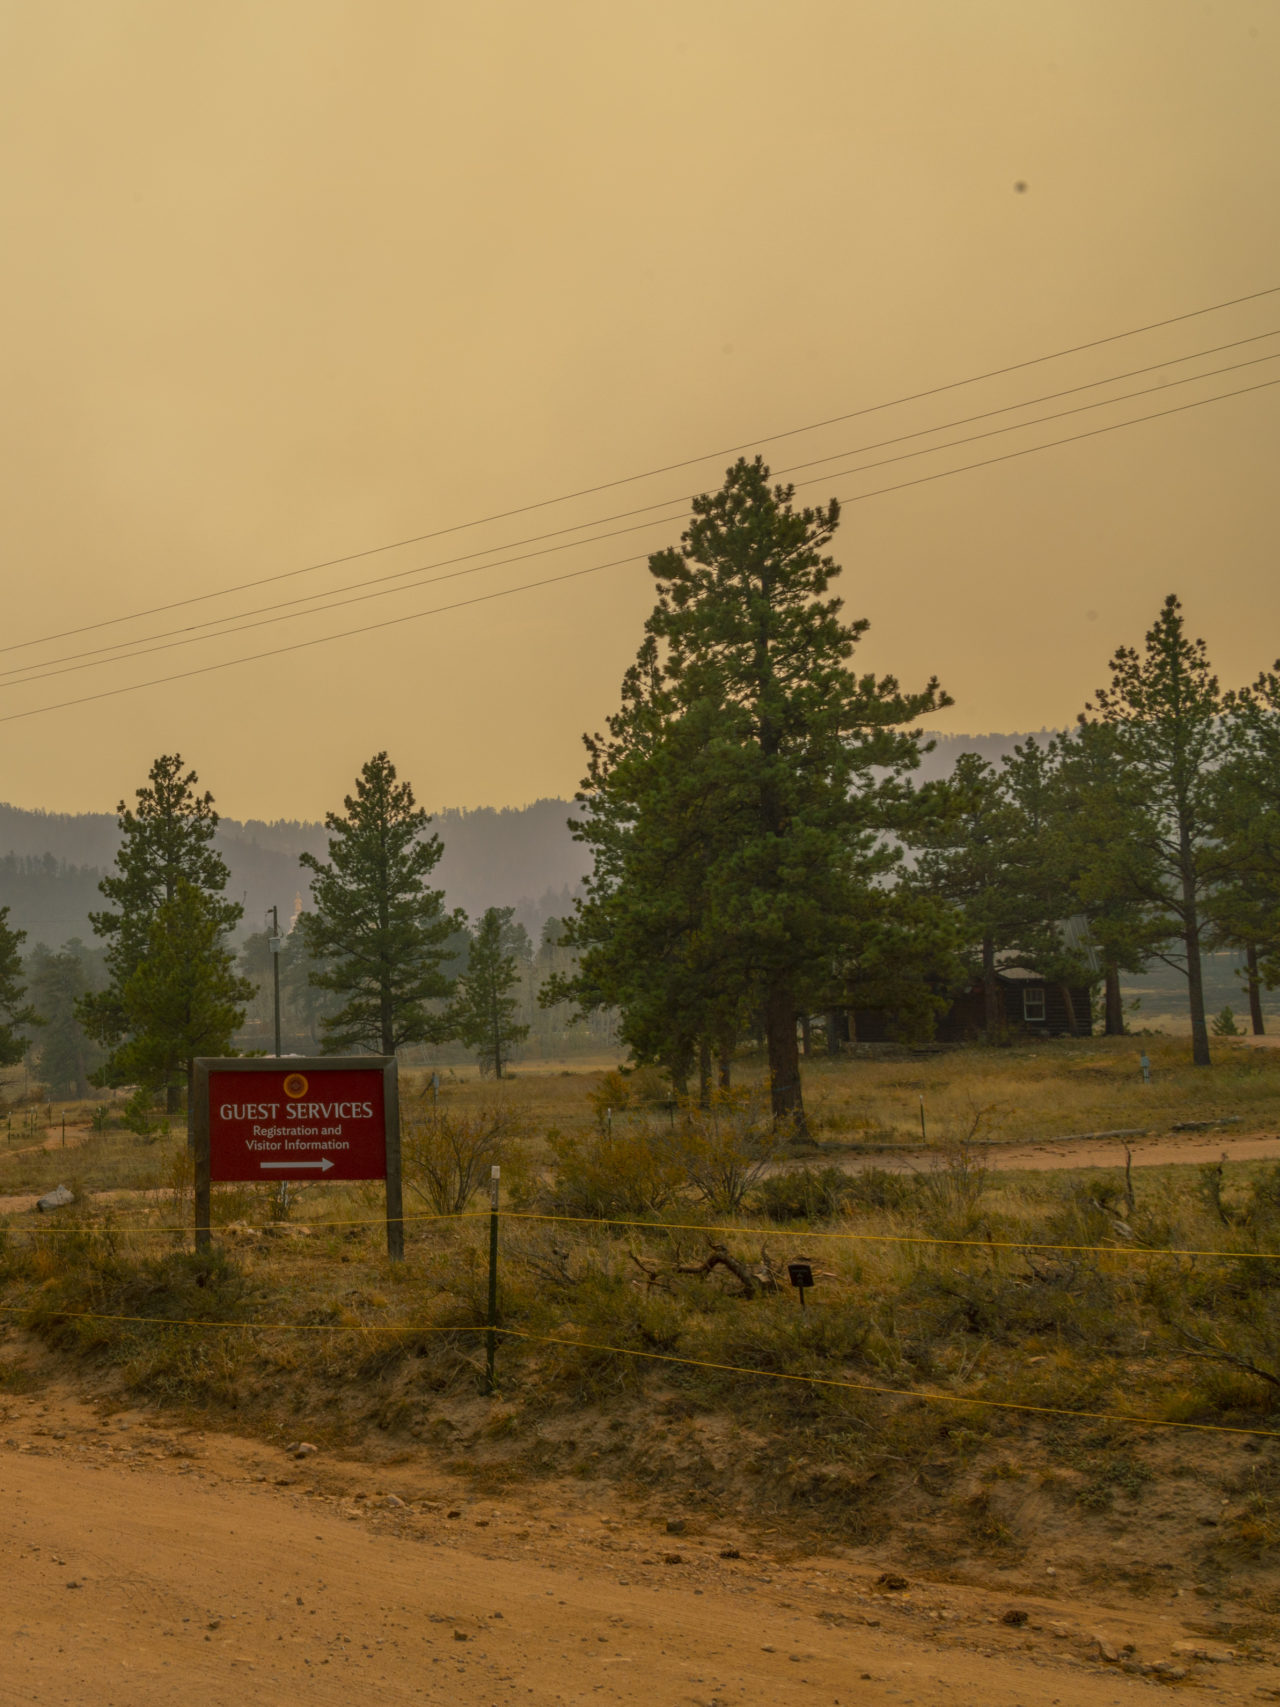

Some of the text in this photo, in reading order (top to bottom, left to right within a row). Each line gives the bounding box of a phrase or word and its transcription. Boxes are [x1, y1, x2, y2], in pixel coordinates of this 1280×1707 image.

[220, 1102, 373, 1119] GUEST SERVICES
[253, 1124, 342, 1138] Registration and
[245, 1140, 350, 1151] Visitor Information
